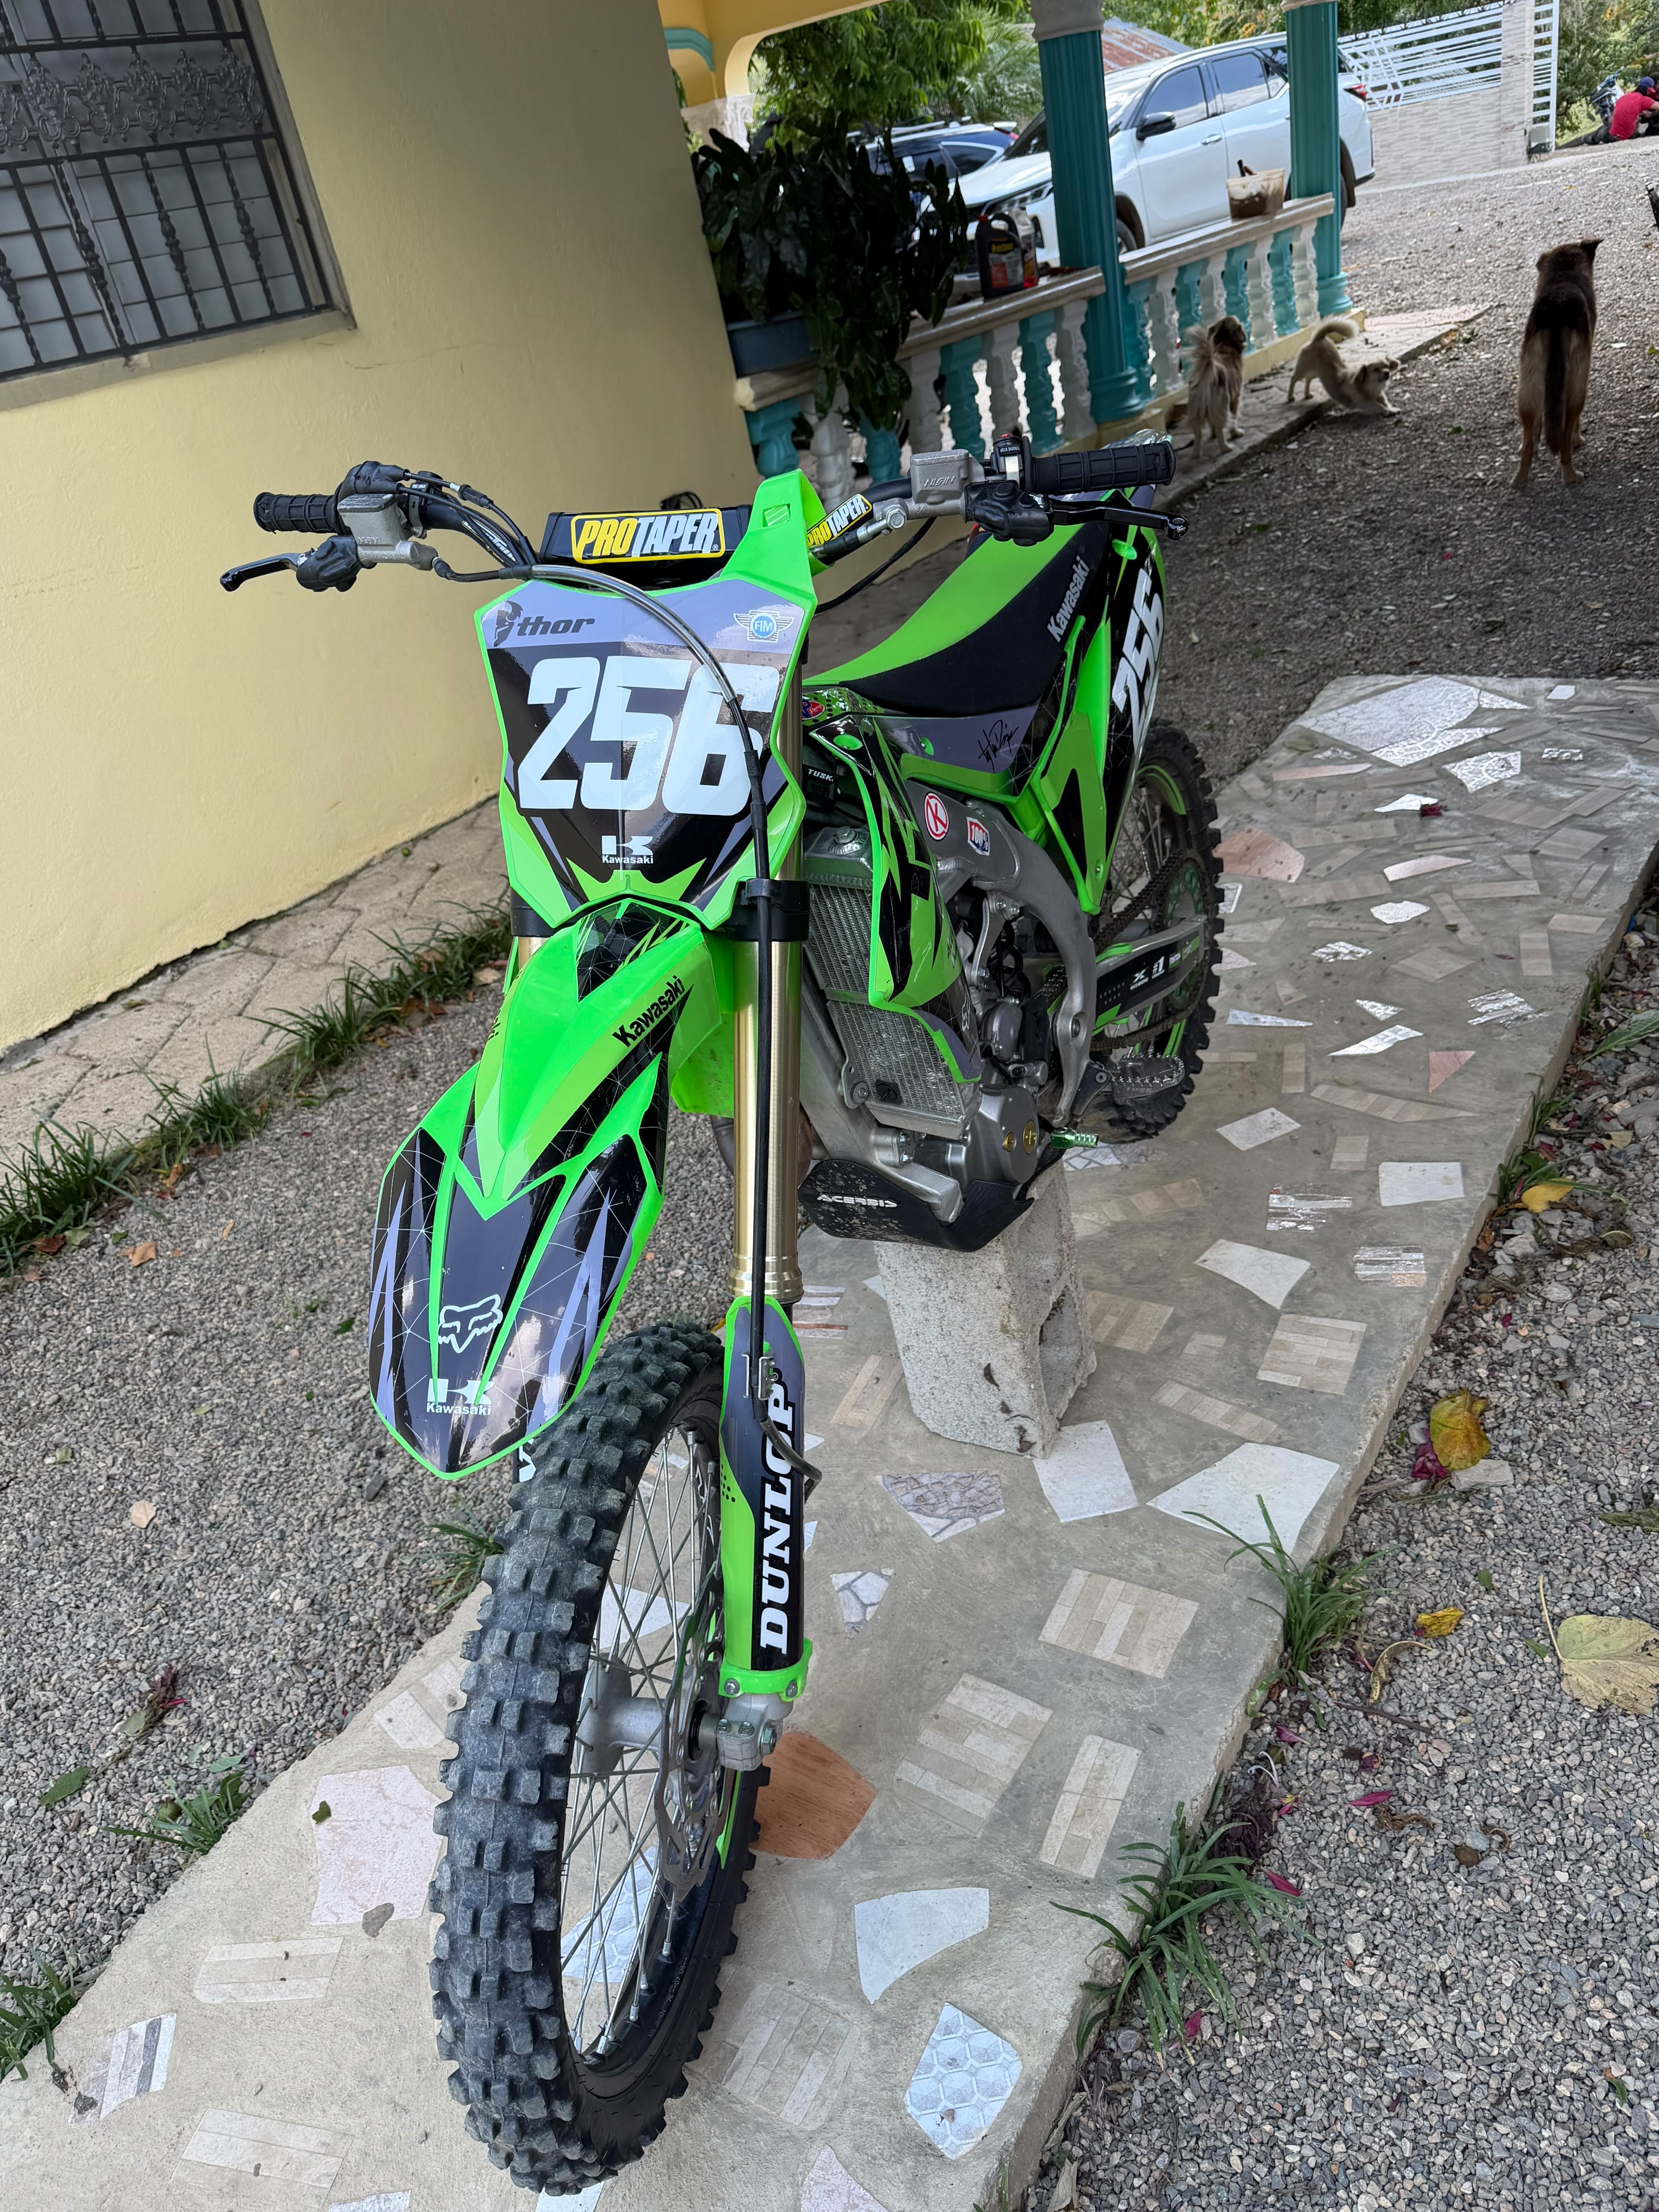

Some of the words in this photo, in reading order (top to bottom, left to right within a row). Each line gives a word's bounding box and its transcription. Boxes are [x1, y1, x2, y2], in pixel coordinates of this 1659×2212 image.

[1047, 555, 1090, 643] Kawasaki
[517, 615, 595, 636] thor
[754, 620, 773, 632] FIM
[518, 656, 779, 816] 256
[808, 769, 833, 782] TUSK
[971, 824, 988, 851] 100%
[602, 855, 654, 864] Kawasaki
[612, 975, 685, 1048] Kawasaki
[426, 1402, 492, 1416] Kawasaki
[760, 1382, 793, 1655] DUNLOP
[655, 2009, 667, 2027] JAPAN
